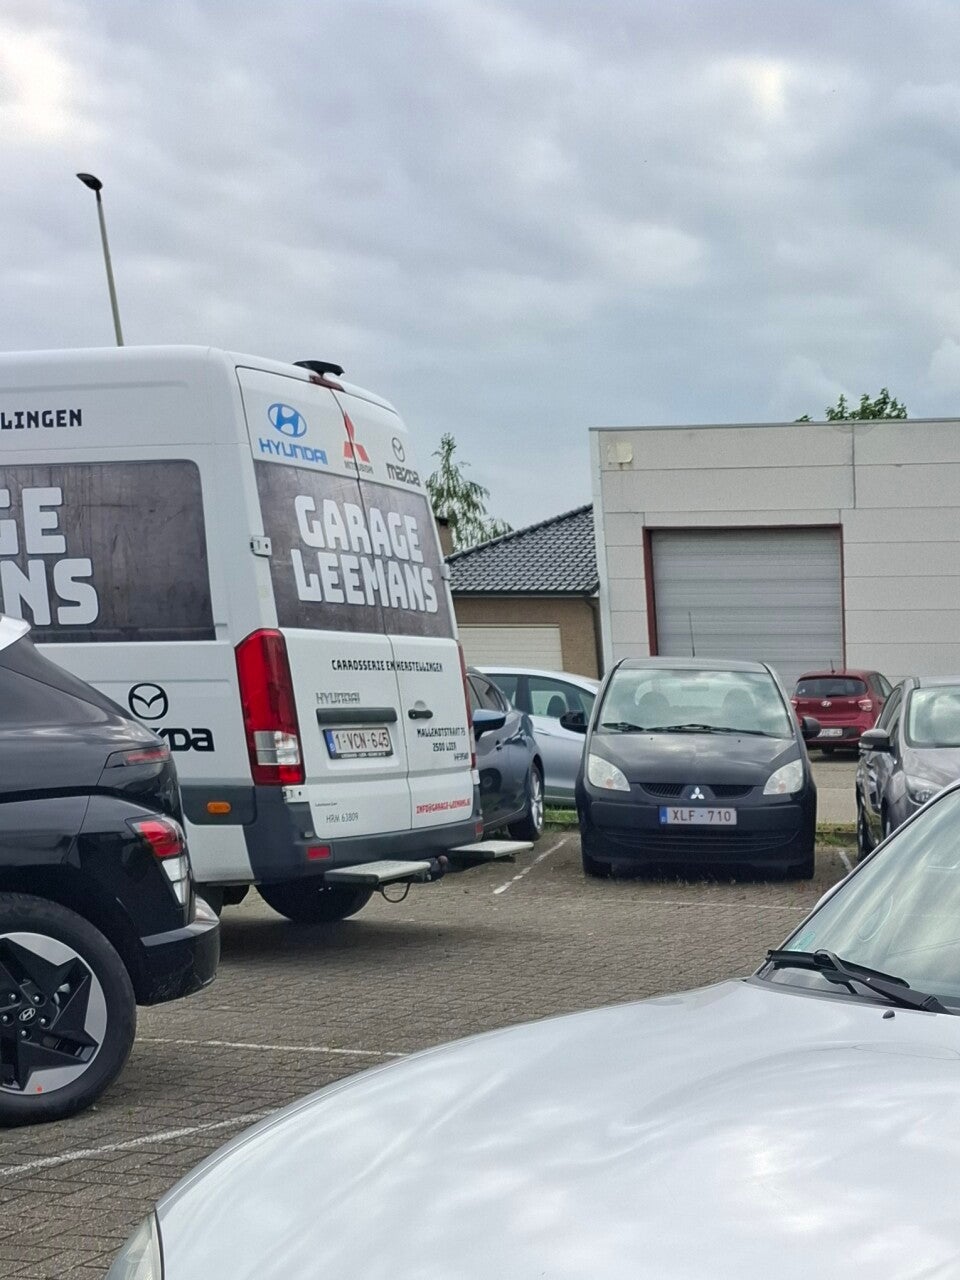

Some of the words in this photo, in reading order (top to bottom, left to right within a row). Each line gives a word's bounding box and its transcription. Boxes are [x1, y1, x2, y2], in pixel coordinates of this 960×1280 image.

[259, 438, 328, 465] HYUNDAI
[295, 495, 424, 563] GARAGE
[291, 549, 438, 613] LEEMANS
[331, 660, 386, 671] CARROSSERIE
[396, 661, 443, 672] HERSTELLINGEN
[316, 692, 360, 704] HYUNDAI
